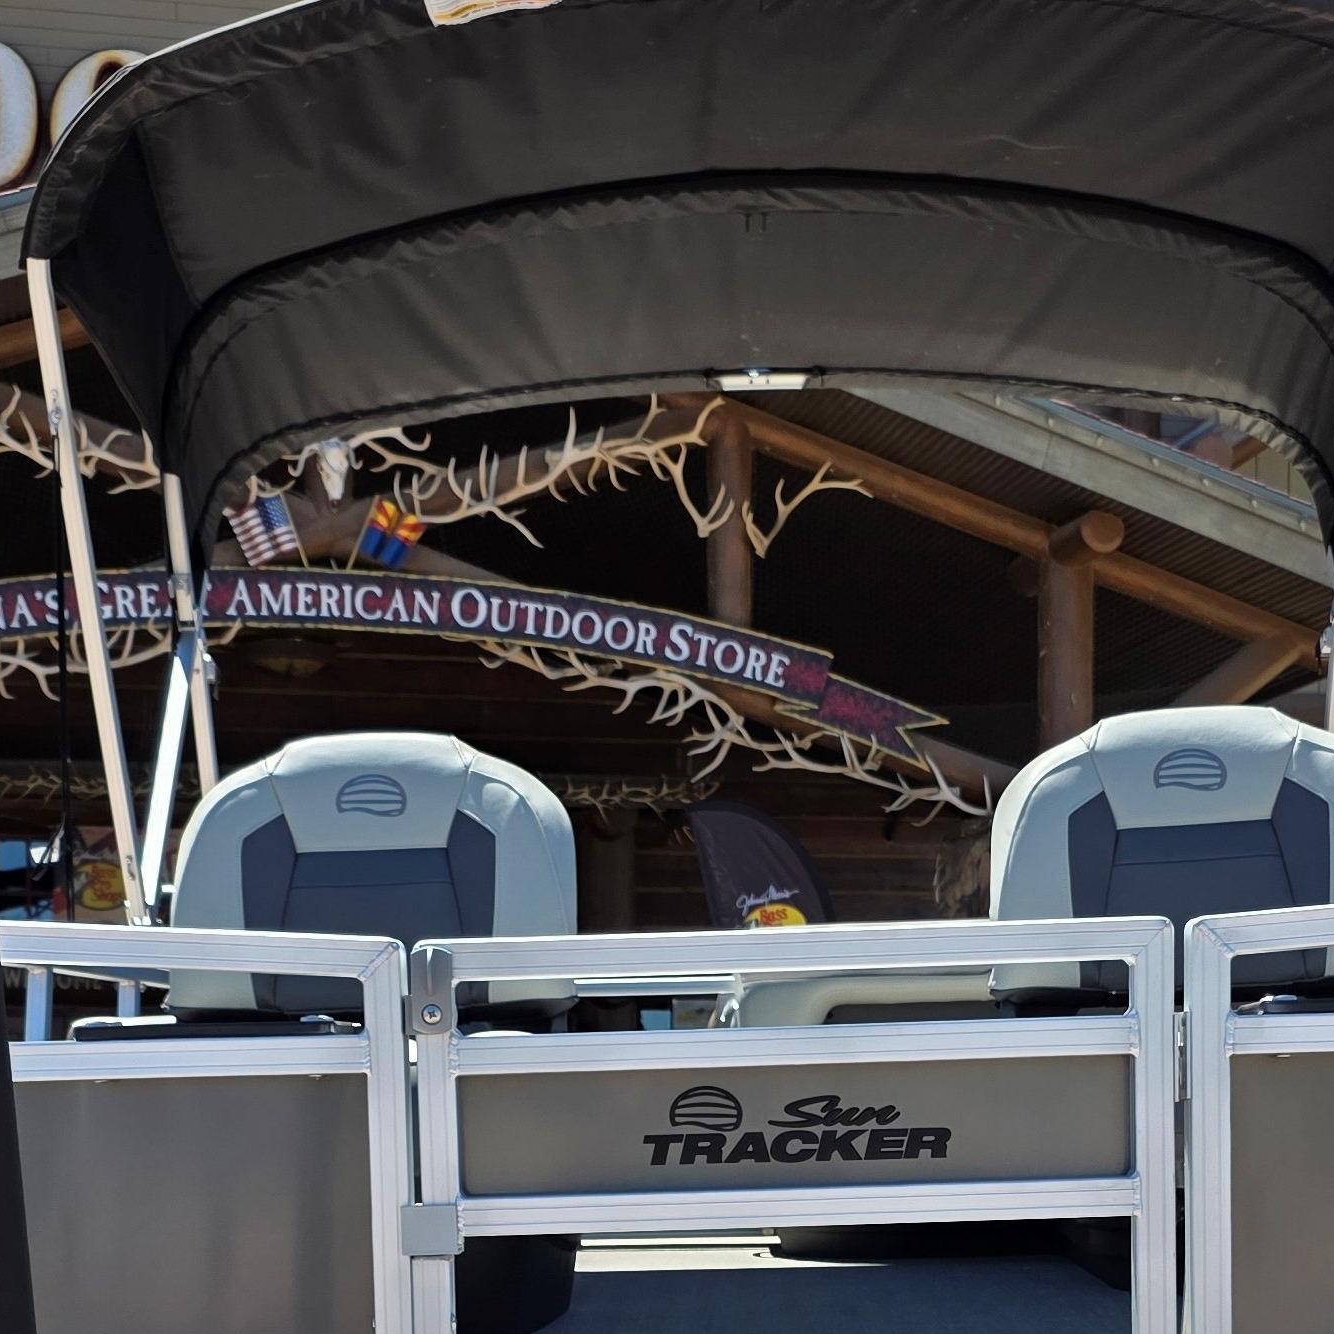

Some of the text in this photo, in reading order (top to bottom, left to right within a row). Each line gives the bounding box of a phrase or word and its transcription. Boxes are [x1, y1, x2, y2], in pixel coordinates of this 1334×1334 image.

[226, 578, 440, 626] AMERICAN
[451, 588, 657, 657] OUTDOOR
[665, 621, 791, 690] STORE
[759, 908, 788, 926] Bass
[768, 1094, 901, 1128] Sun
[643, 1127, 952, 1166] TRACKER
